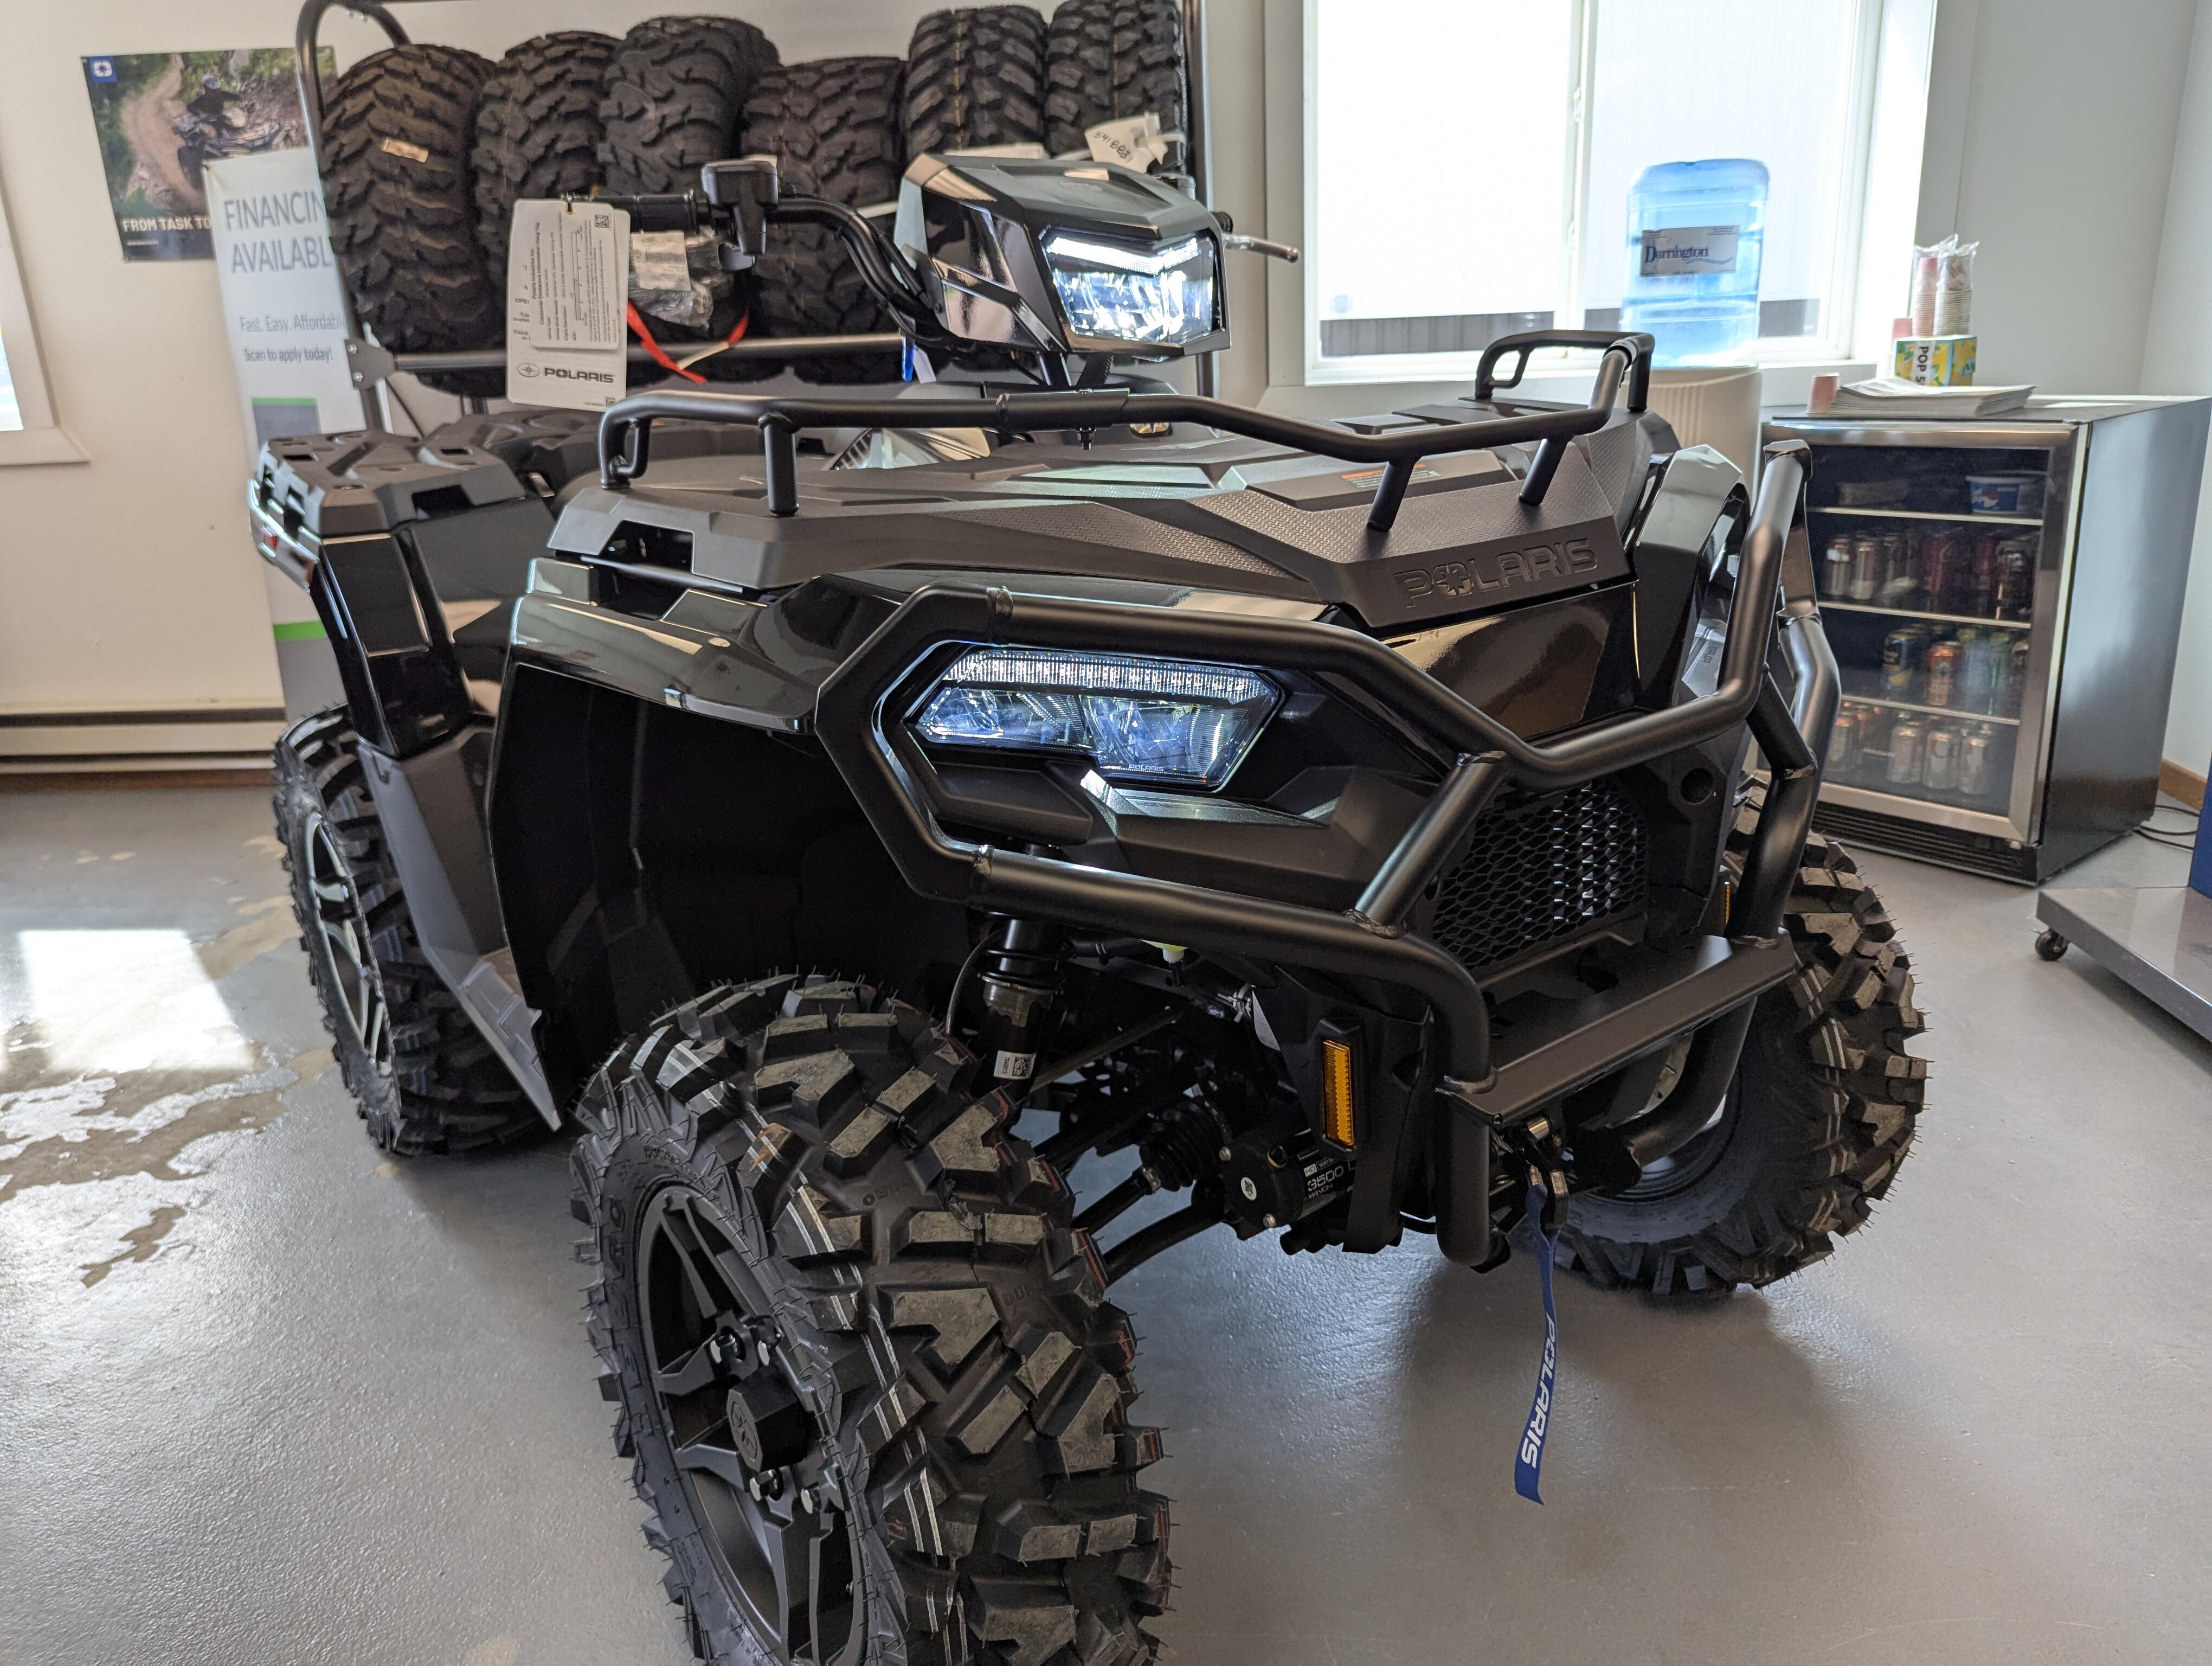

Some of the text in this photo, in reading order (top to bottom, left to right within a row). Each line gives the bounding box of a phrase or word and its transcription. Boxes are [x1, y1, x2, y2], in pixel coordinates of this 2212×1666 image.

[122, 214, 213, 233] FROM TASK TO
[244, 345, 333, 363] Scan to apply today!
[1915, 346, 1929, 373] POP
[544, 367, 615, 383] POLARIS
[1393, 537, 1598, 608] POLARIS
[1305, 1165, 1316, 1175] HD
[1307, 1165, 1344, 1192] 3500
[1521, 1311, 1556, 1469] POLARIS
